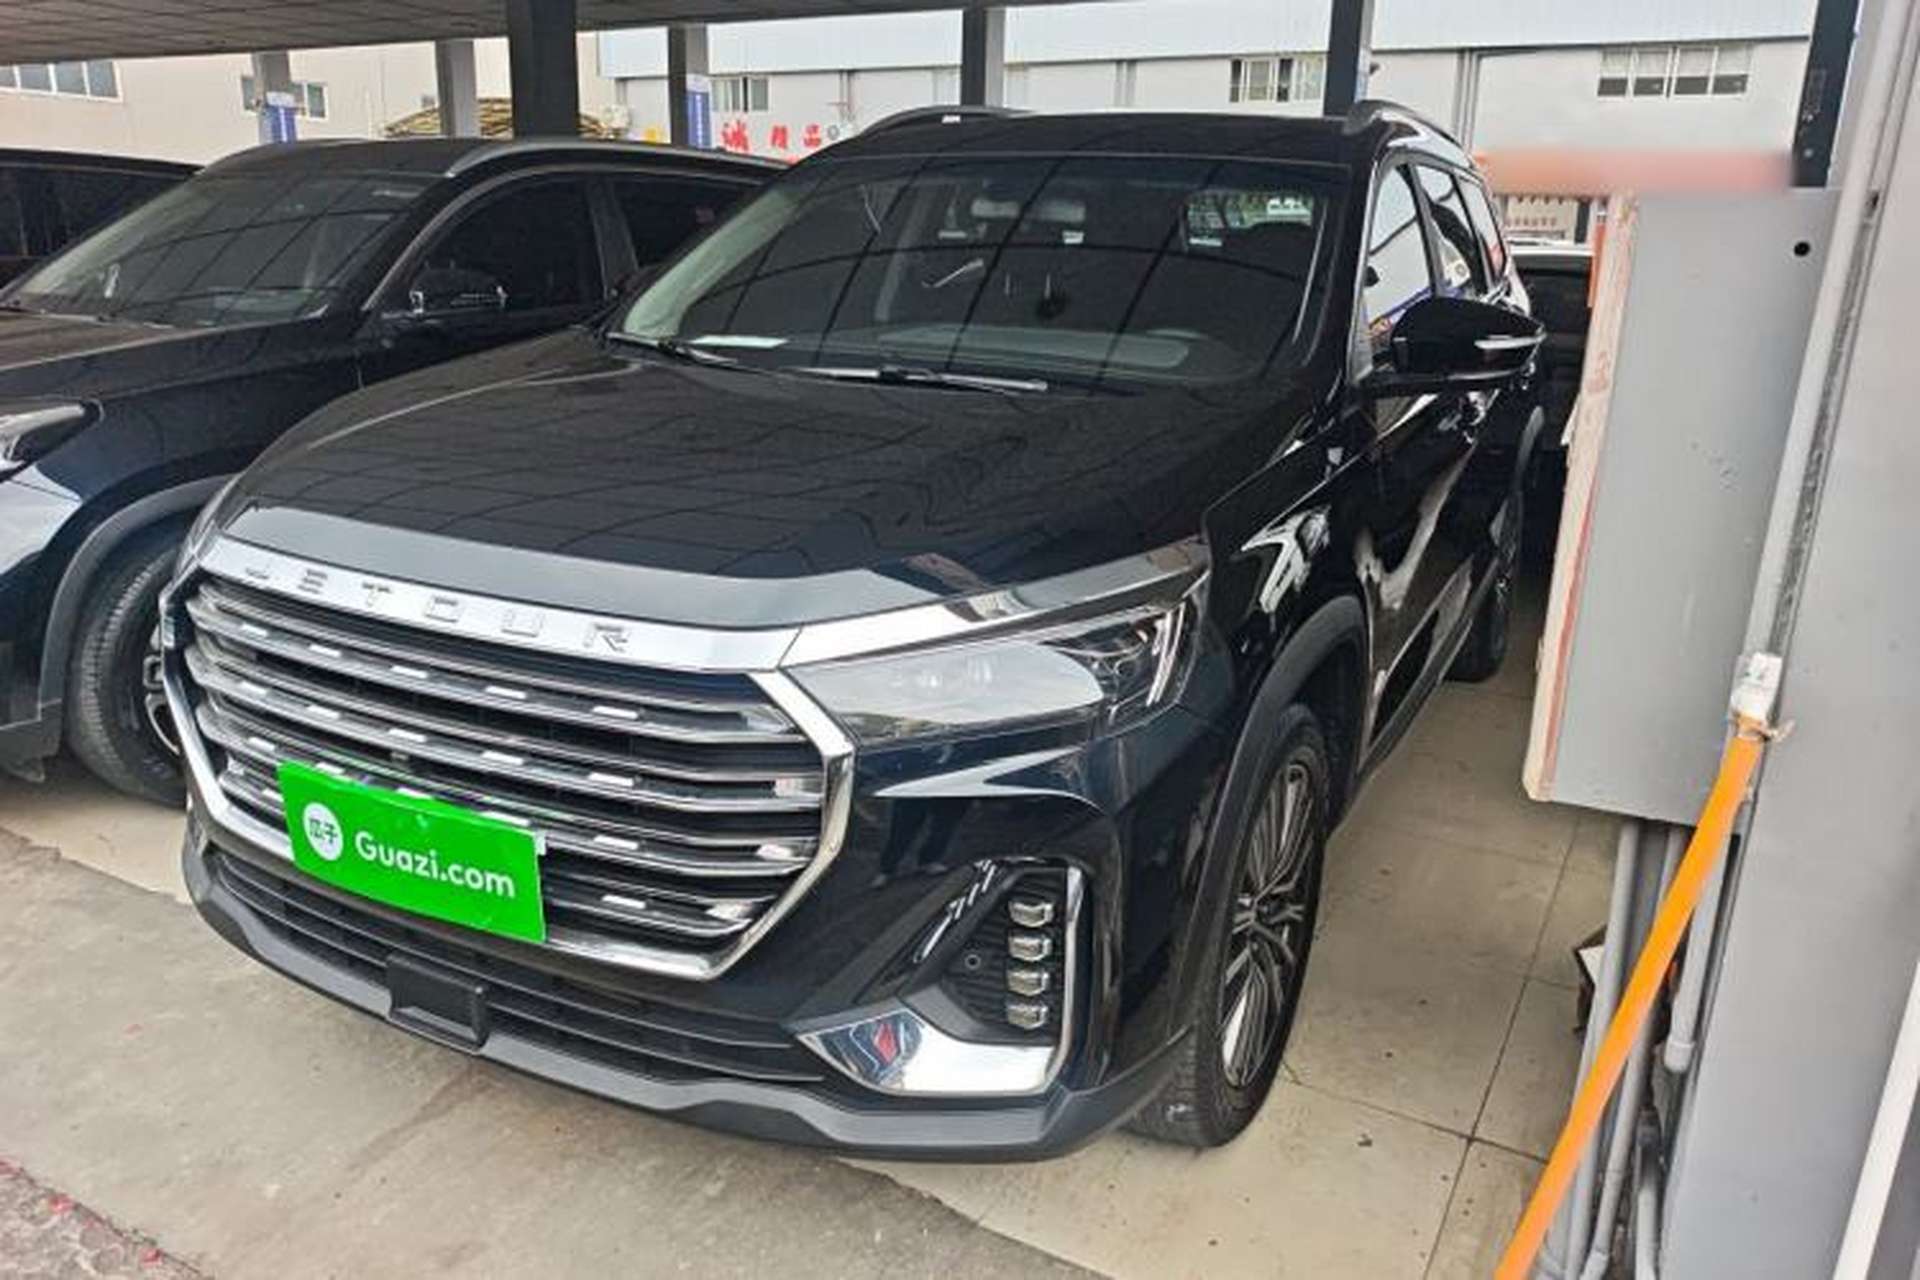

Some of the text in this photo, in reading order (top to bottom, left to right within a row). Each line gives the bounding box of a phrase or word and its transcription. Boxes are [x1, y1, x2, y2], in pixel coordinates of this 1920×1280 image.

[245, 562, 631, 653] JETOUR
[308, 817, 515, 898] 瓜子 Guazi.com
